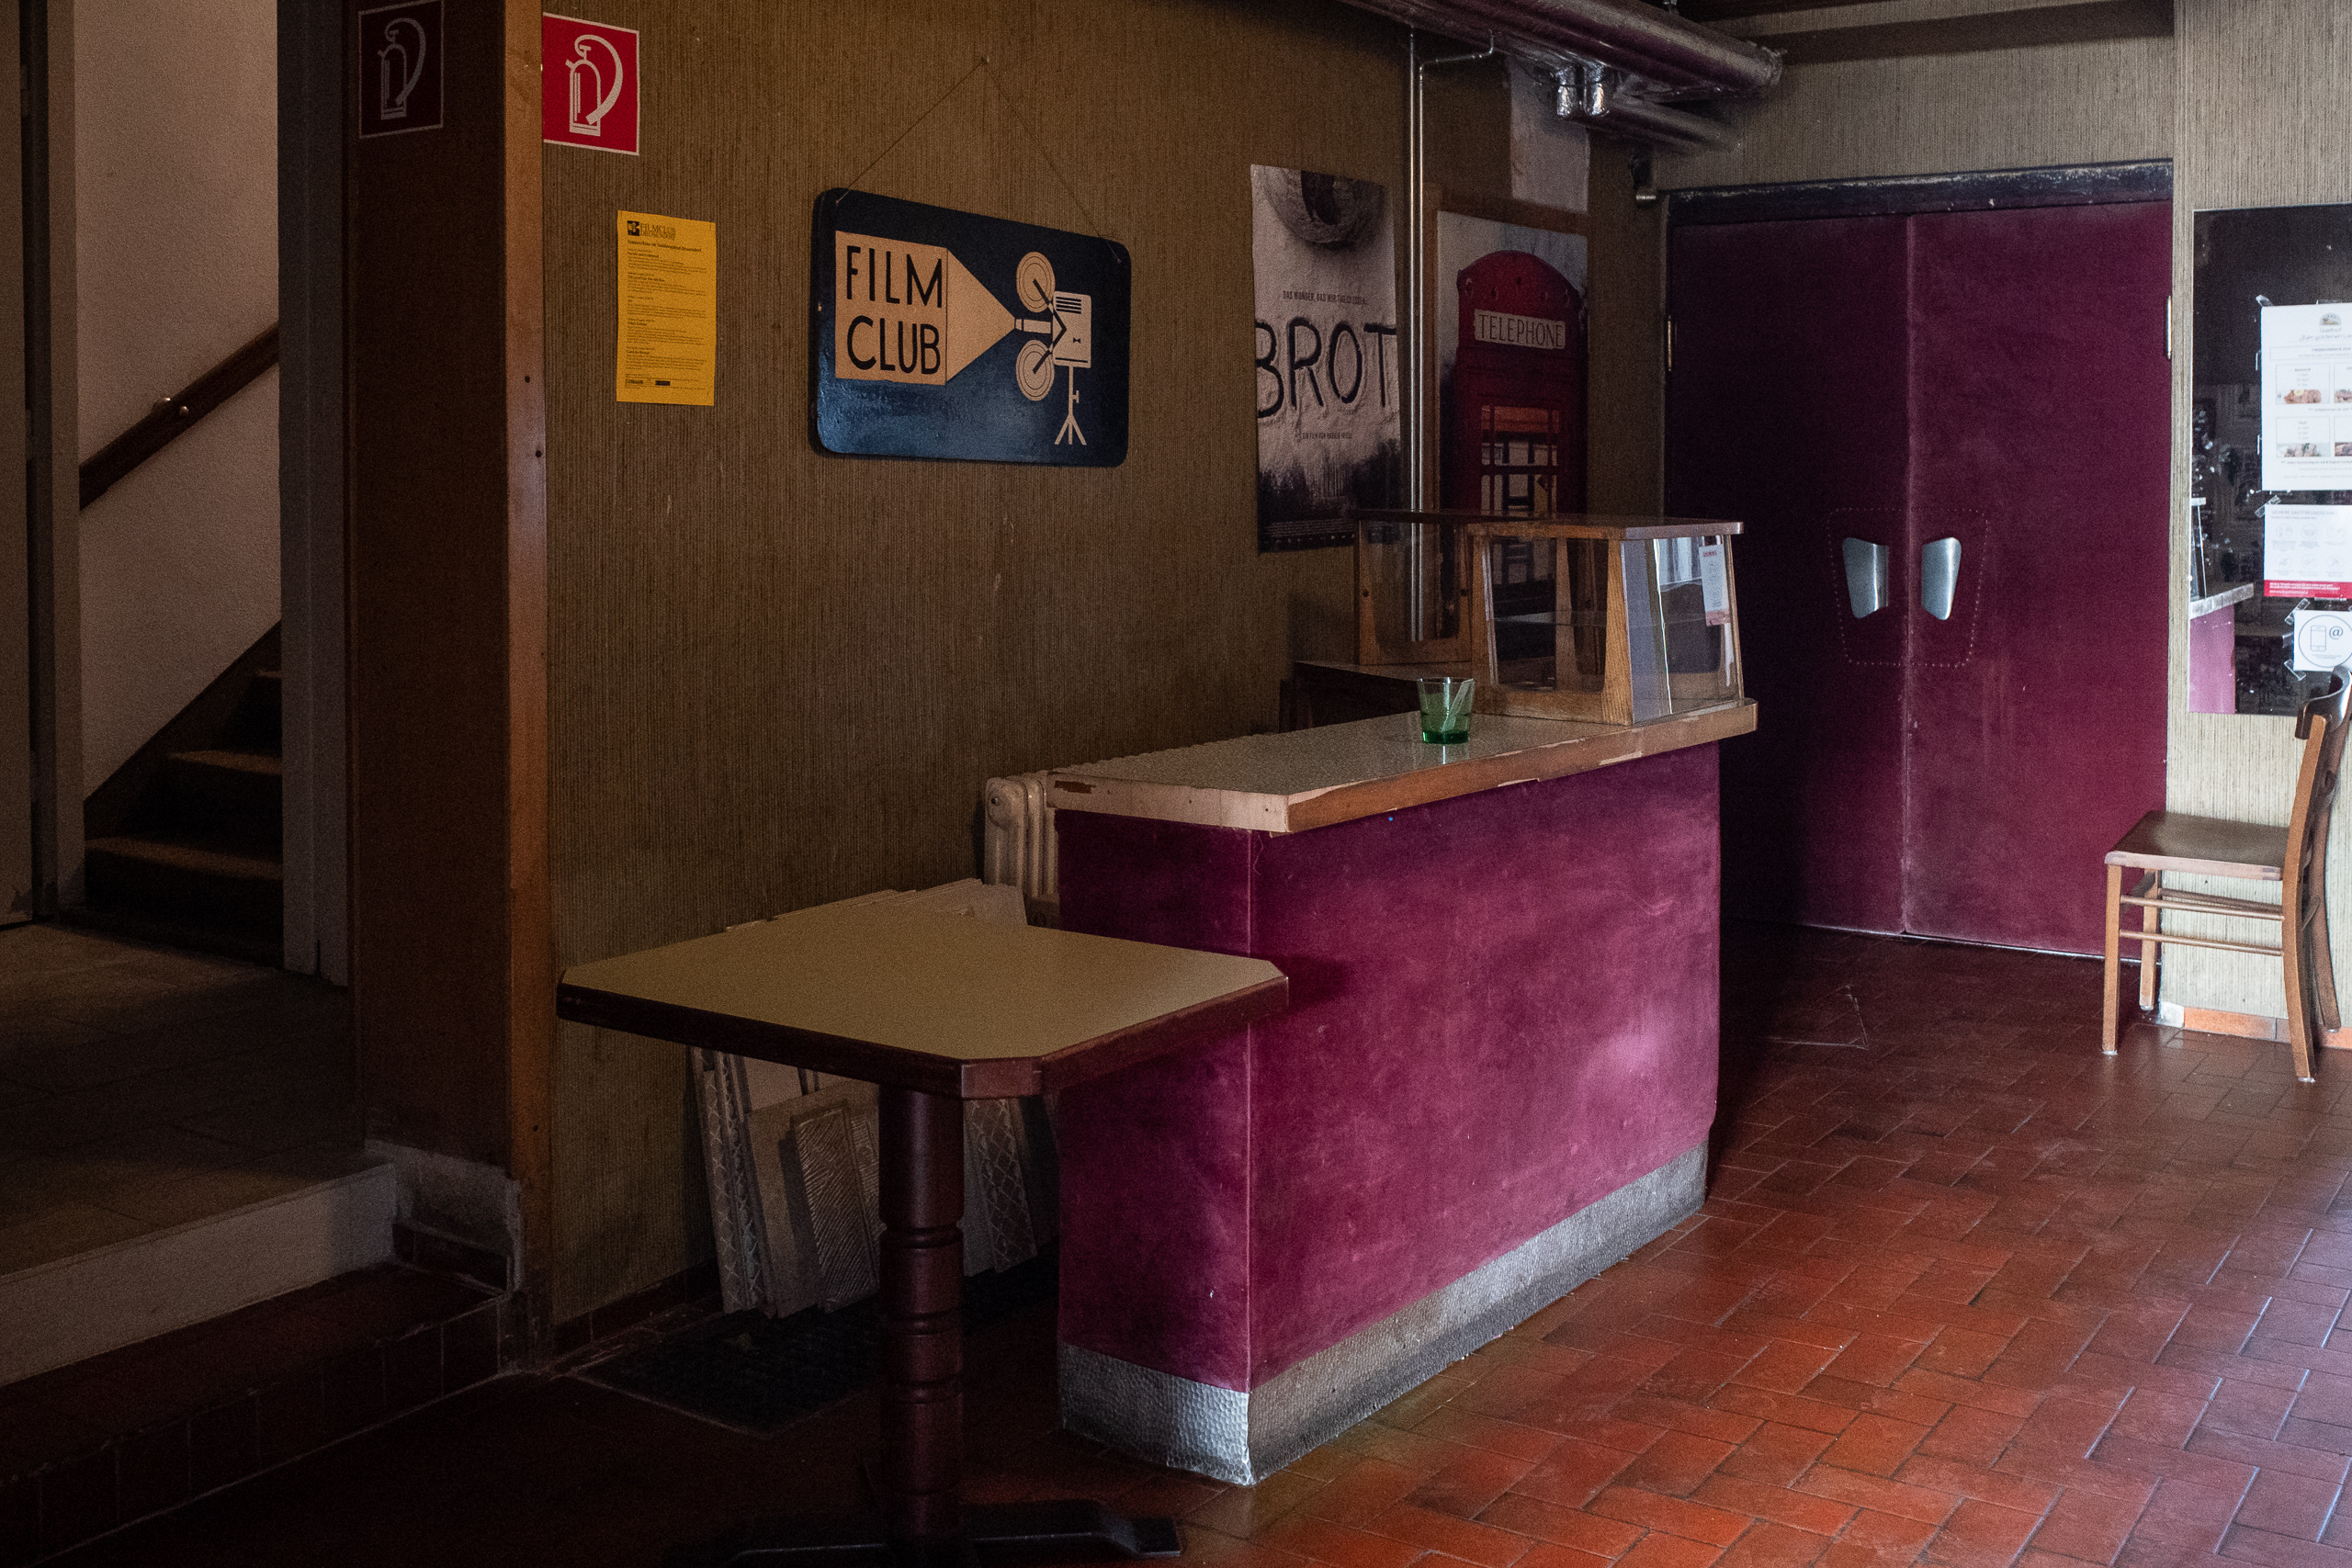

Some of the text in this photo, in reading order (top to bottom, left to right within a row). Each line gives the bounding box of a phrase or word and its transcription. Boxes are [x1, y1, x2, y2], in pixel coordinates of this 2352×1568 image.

[846, 244, 943, 309] FILM
[846, 315, 941, 375] CLUB
[1479, 314, 1563, 347] TELEPHONE
[1255, 317, 1397, 419] BROT
